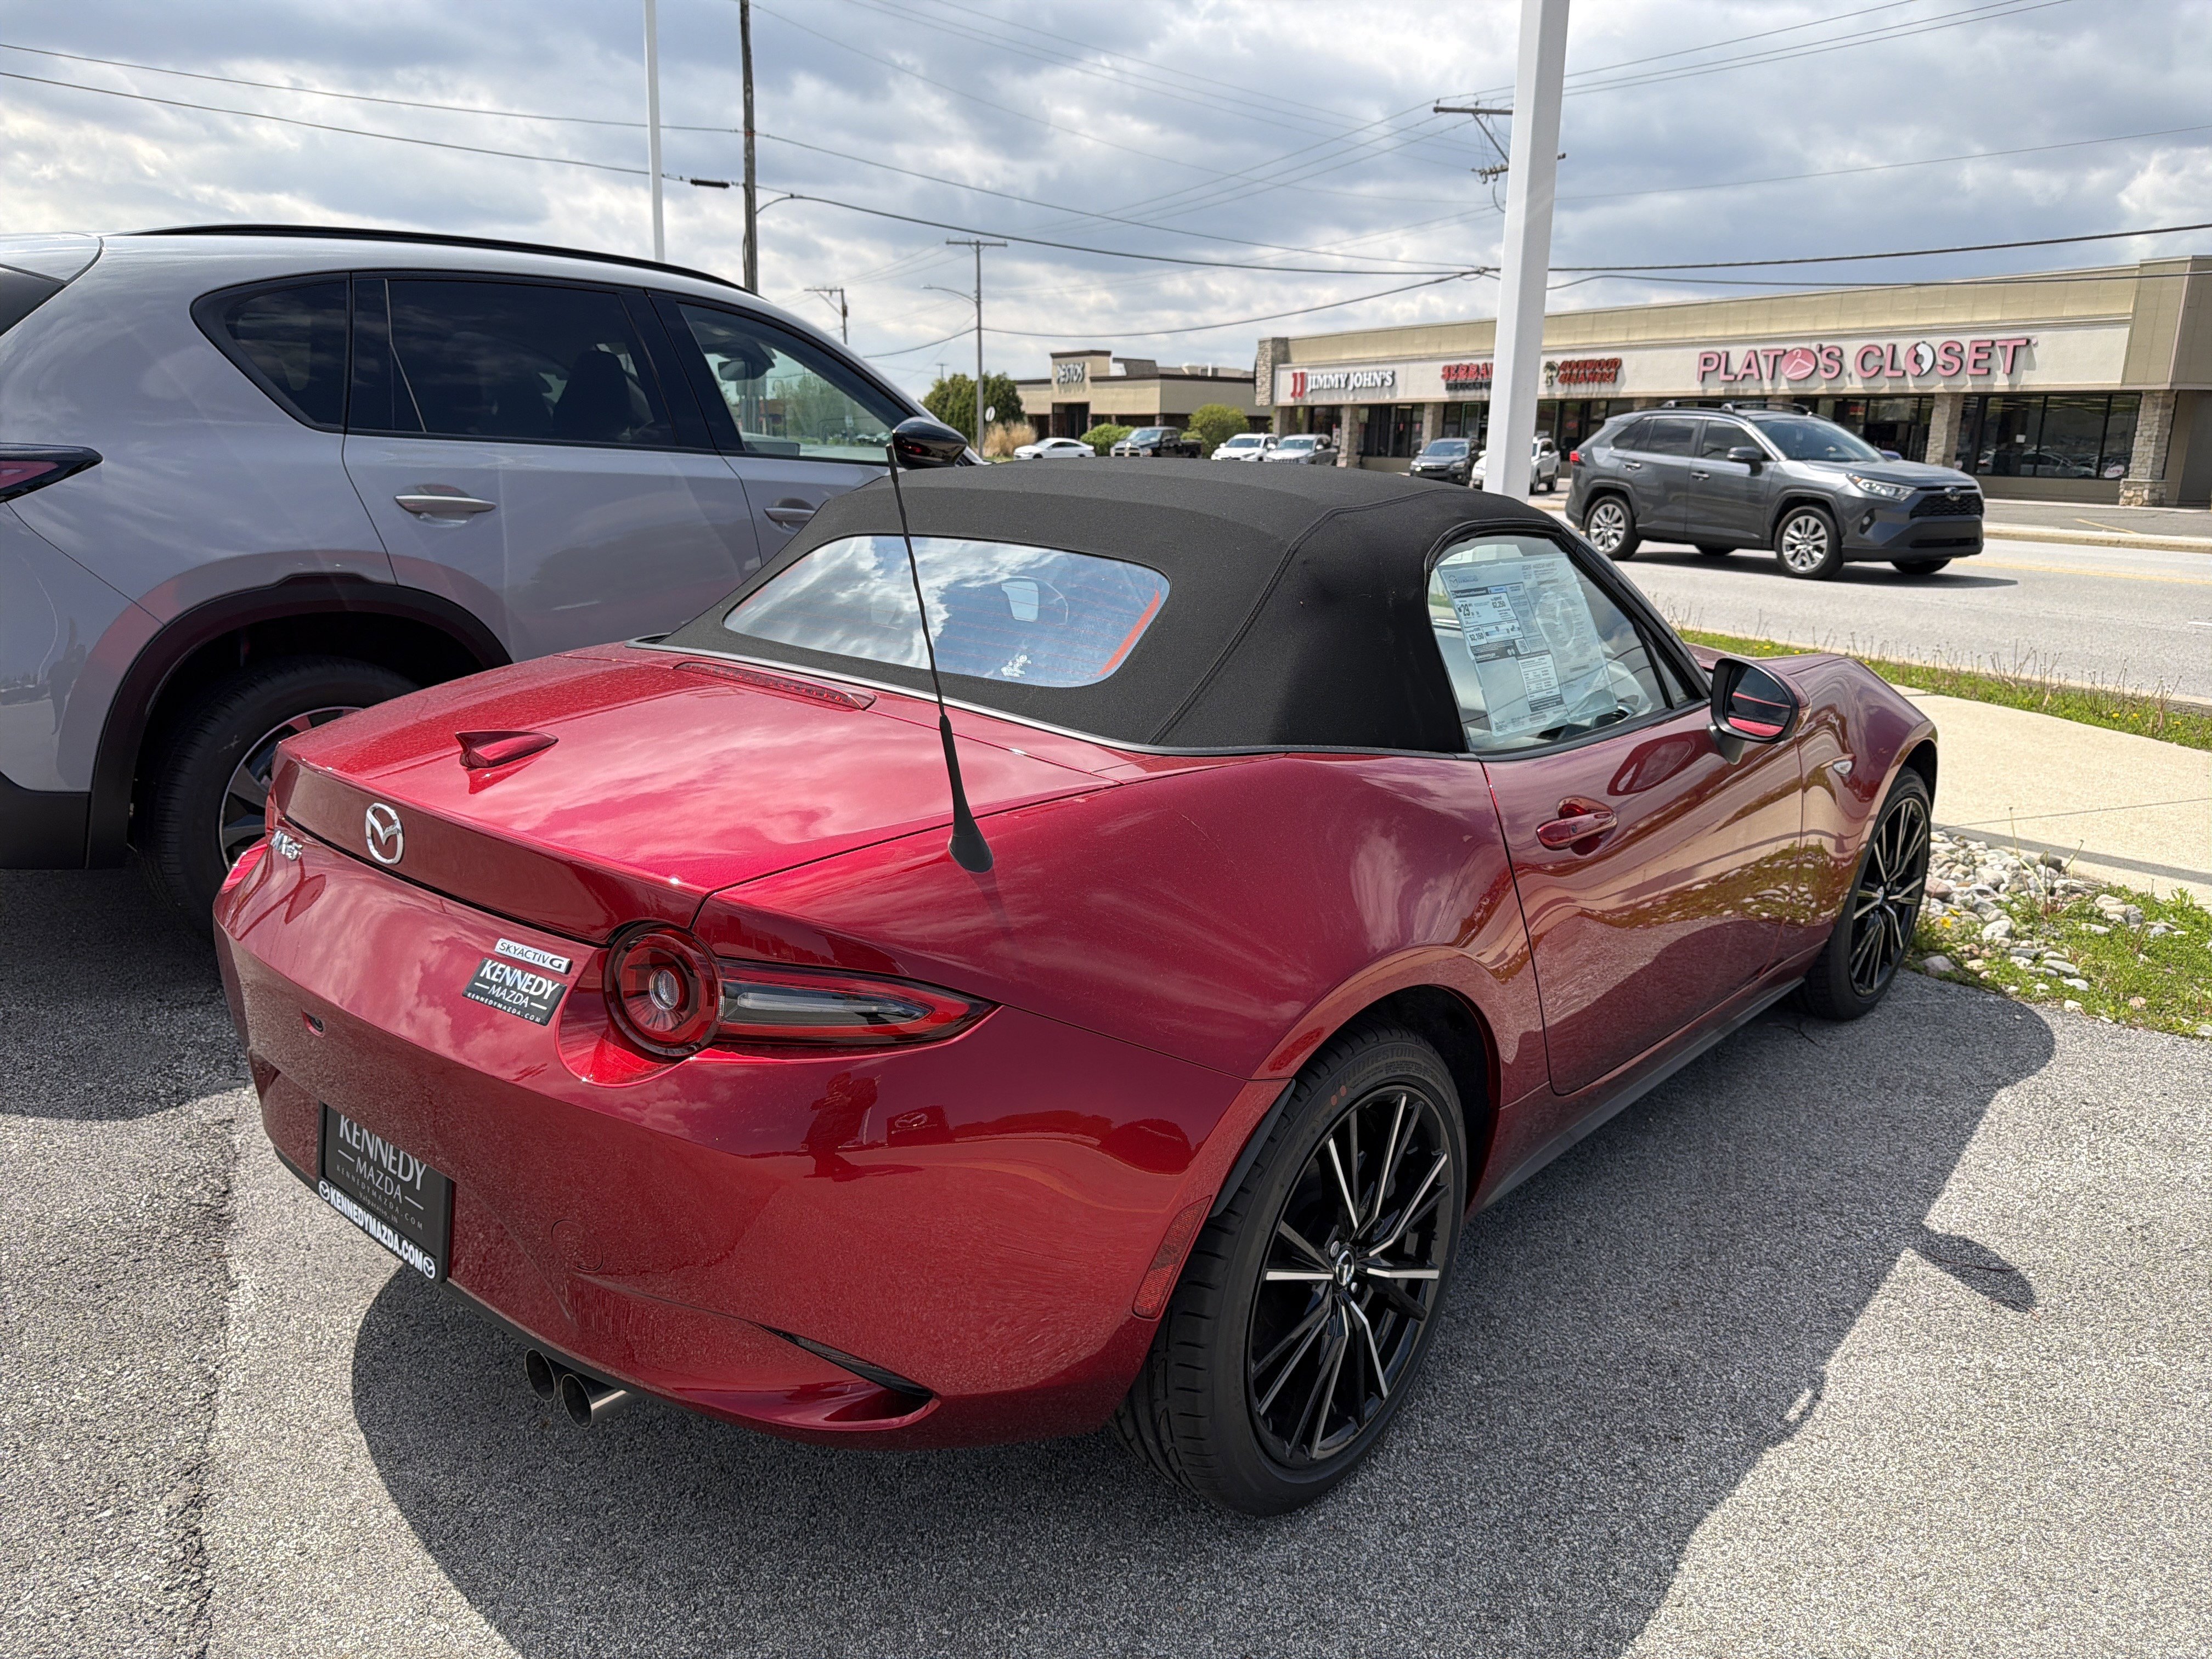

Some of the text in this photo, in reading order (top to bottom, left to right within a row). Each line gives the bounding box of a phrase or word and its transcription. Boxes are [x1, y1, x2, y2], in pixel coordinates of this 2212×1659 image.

[1697, 338, 2030, 381] PLATO'S CLOSET
[1307, 373, 1348, 392] JIMMY
[1348, 371, 1395, 391] JOHN'S
[1462, 603, 1470, 616] 29
[499, 942, 550, 963] SKYACTIV
[480, 960, 560, 1000] KENNEDY
[488, 984, 529, 1008] MAZDA
[467, 992, 541, 1023] KENNEDYMAZDA.COM
[339, 1114, 427, 1192] KENNEDY
[336, 1164, 424, 1231] KENNEDYMAZDA.COM
[356, 1156, 403, 1204] MAZDA
[330, 1188, 424, 1272] KENNEDYMAZDA.COM
